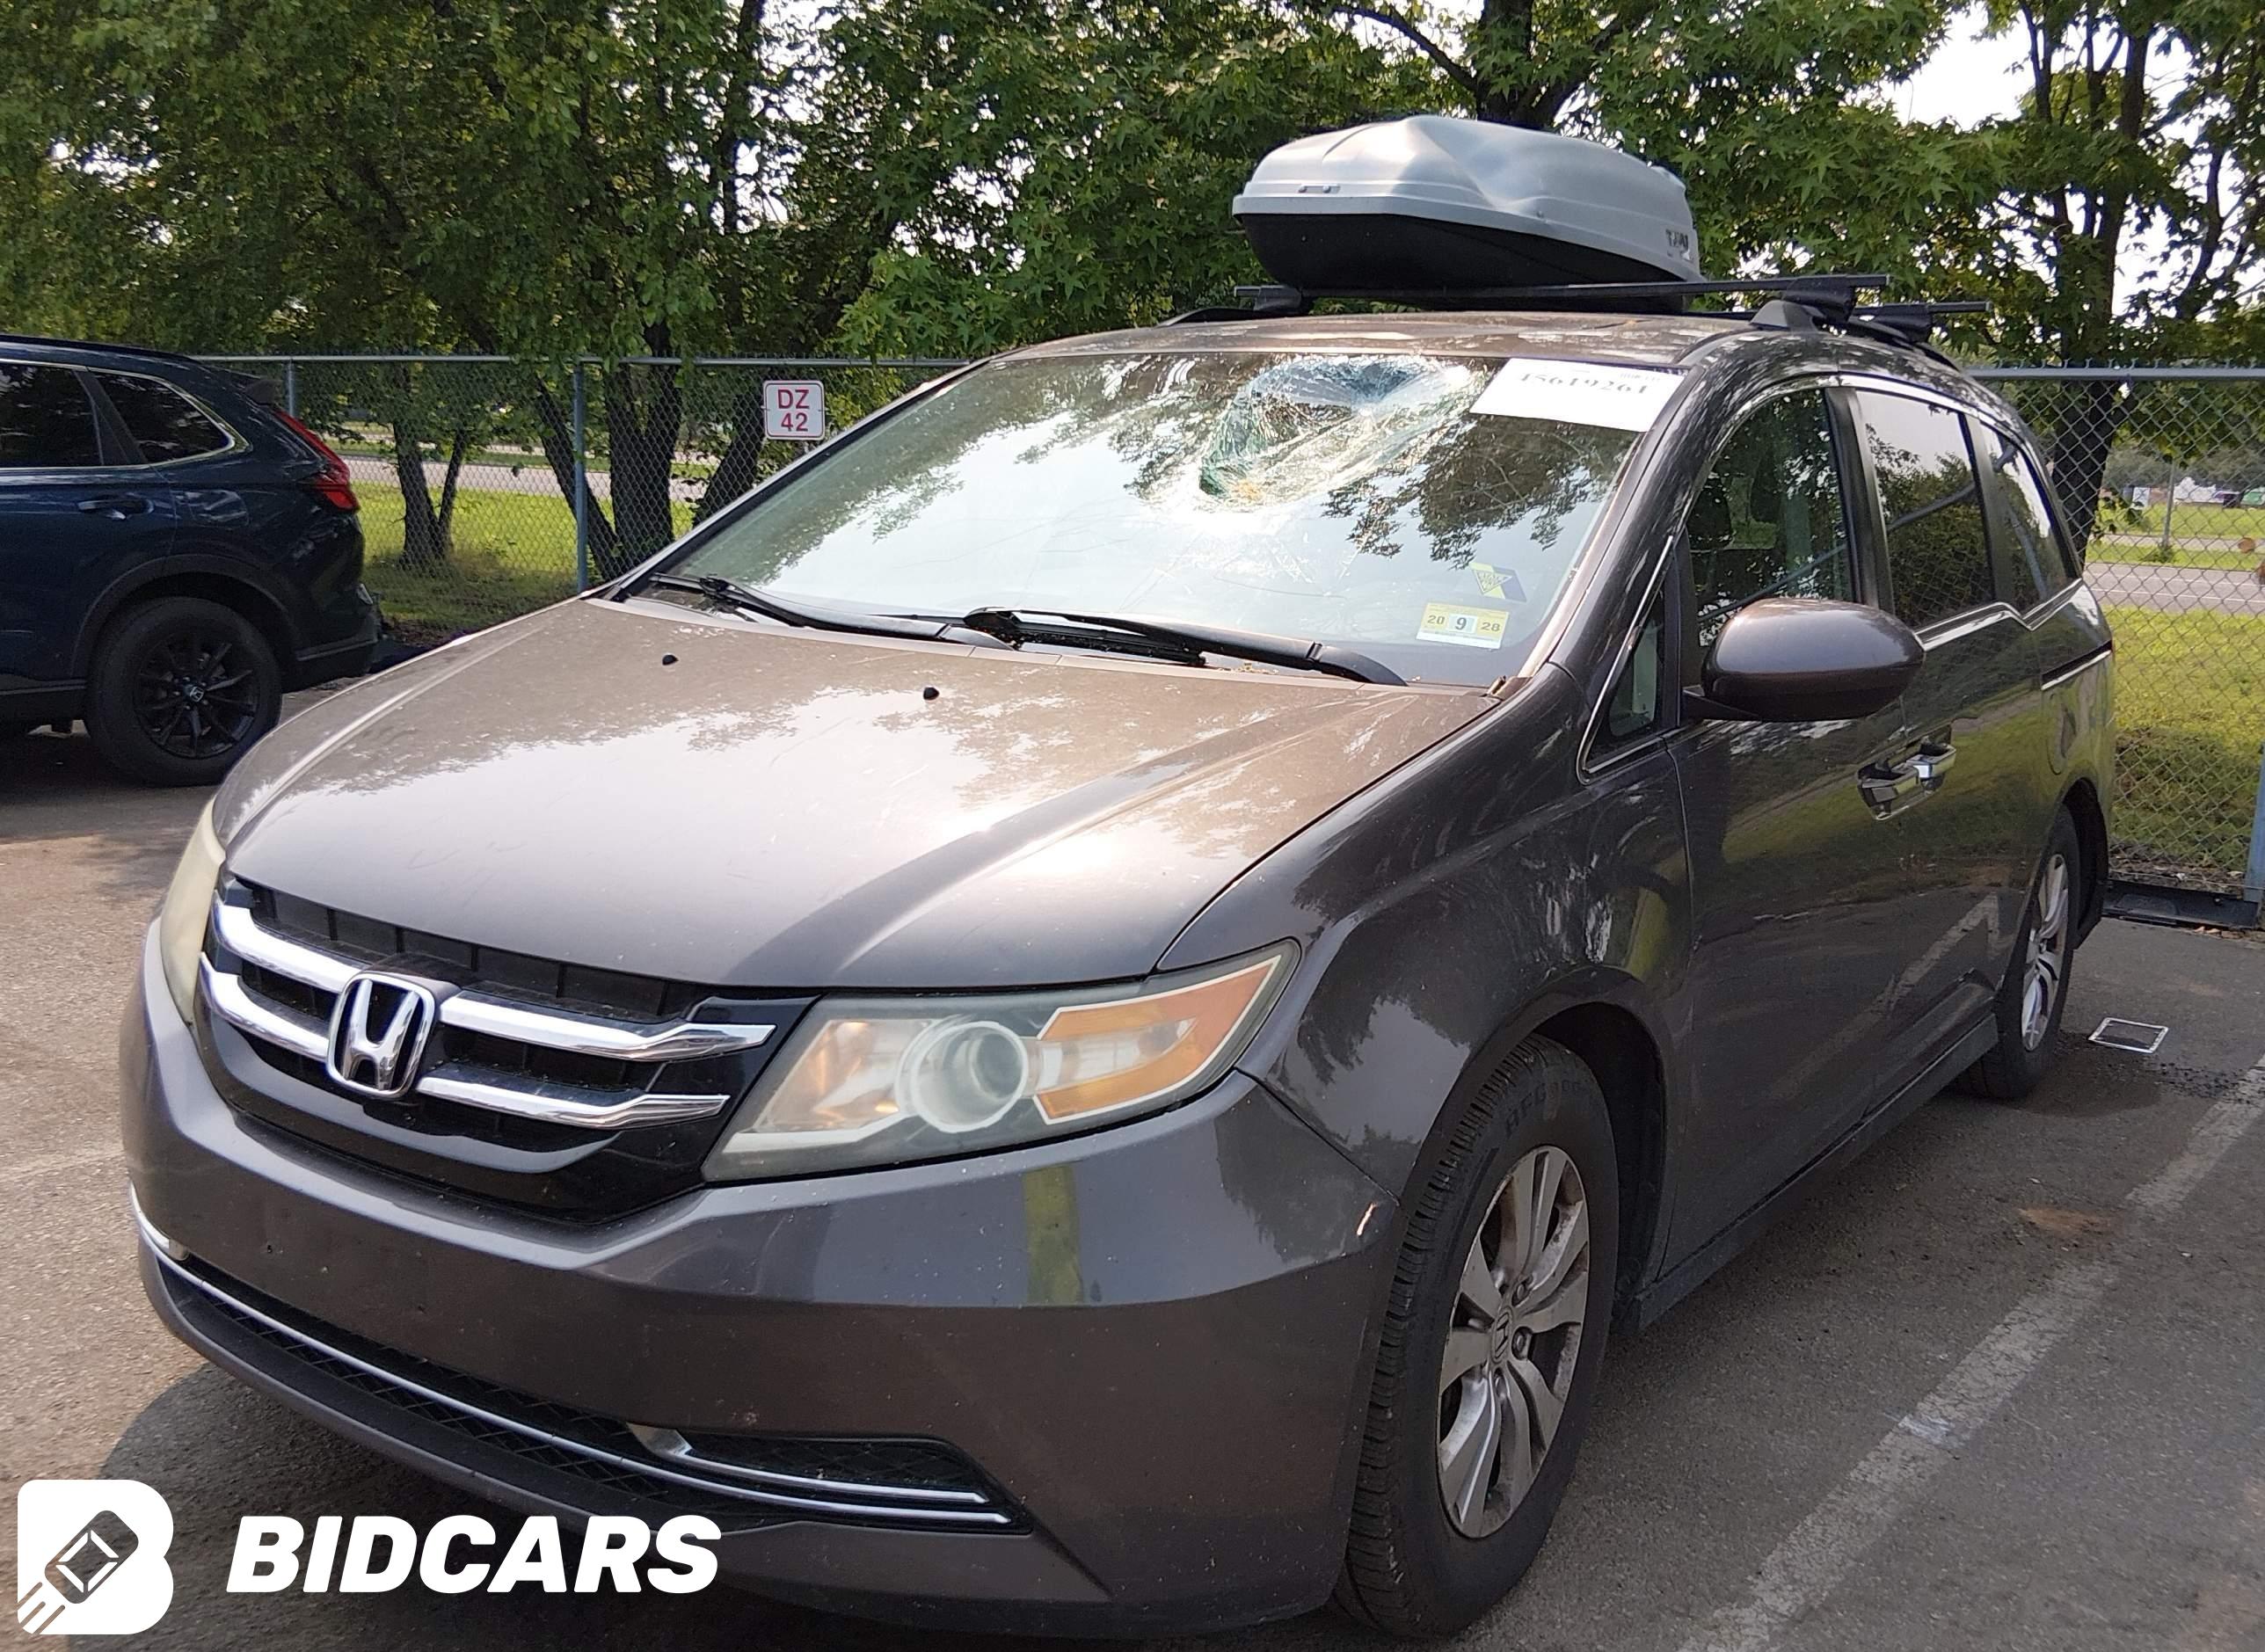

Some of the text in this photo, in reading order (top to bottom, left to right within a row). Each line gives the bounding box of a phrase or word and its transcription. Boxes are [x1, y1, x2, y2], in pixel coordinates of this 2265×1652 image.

[777, 389, 810, 409] DZ
[781, 412, 809, 432] 42
[1427, 615, 1501, 632] 20 9 28
